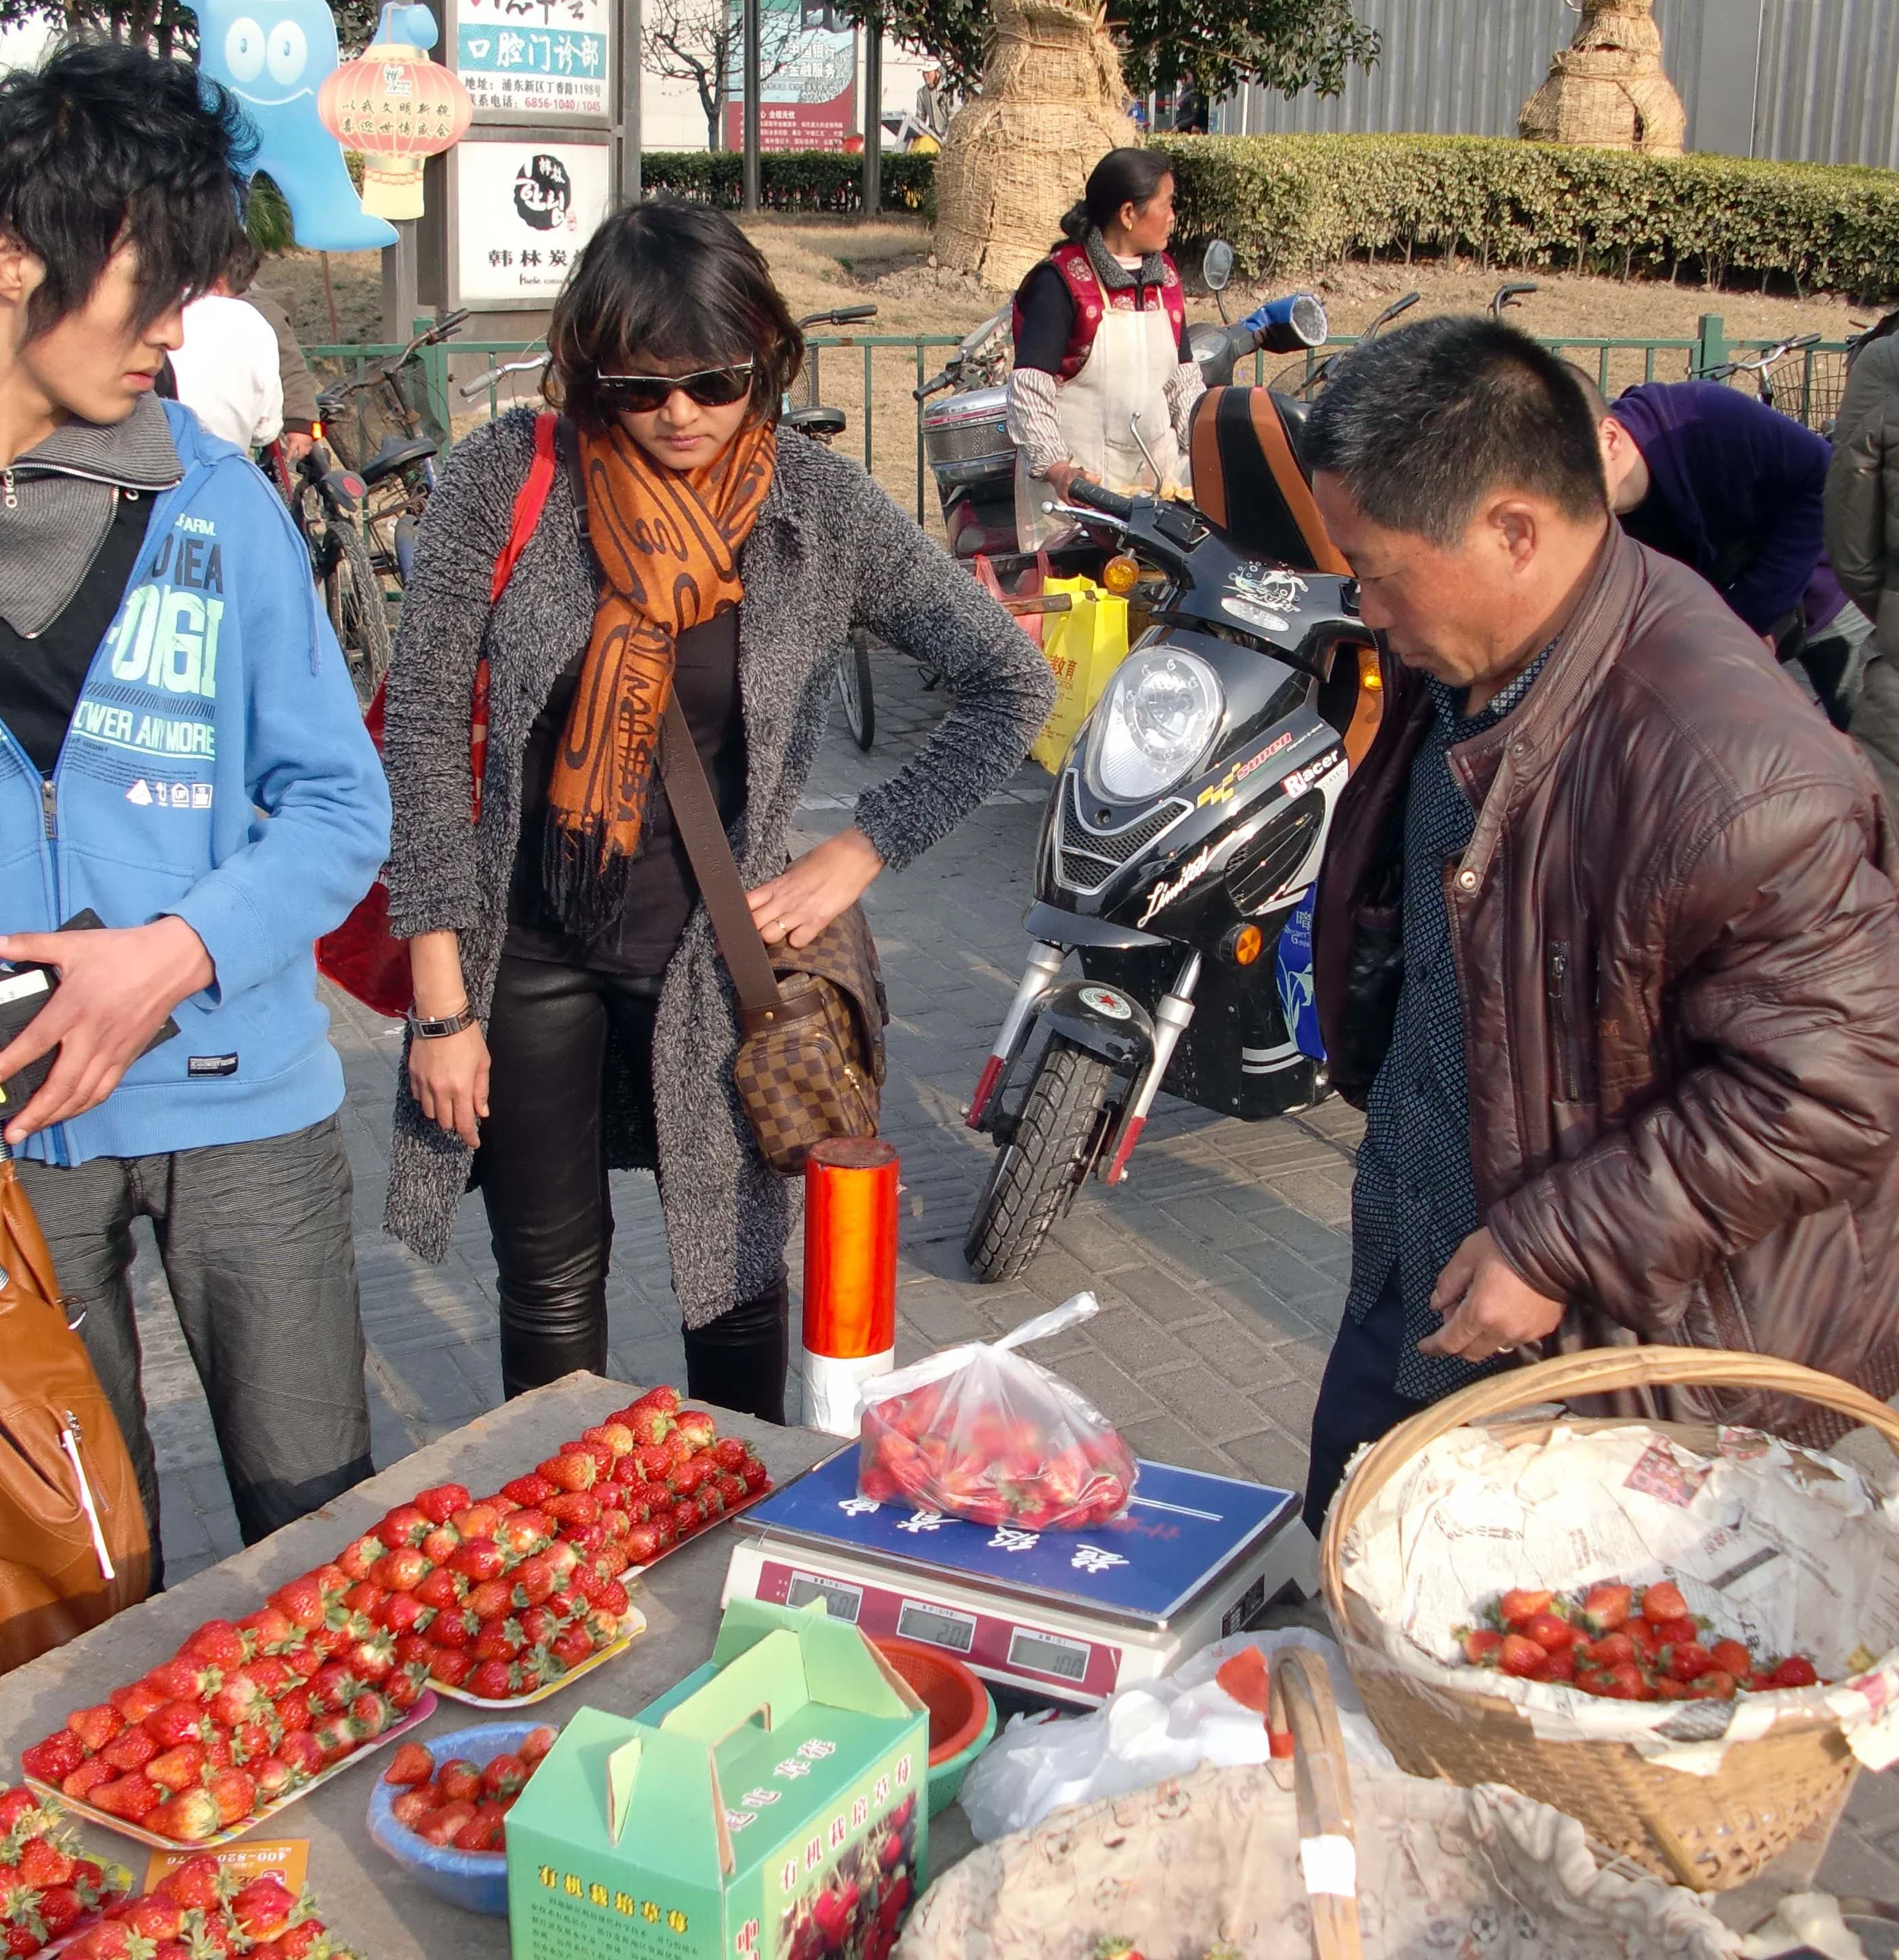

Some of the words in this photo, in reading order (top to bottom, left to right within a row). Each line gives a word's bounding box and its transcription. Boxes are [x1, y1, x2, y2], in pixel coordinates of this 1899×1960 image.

[467, 32, 599, 77] 口腔门诊部
[488, 249, 583, 267] 韩林炭
[1051, 654, 1078, 680] 教育
